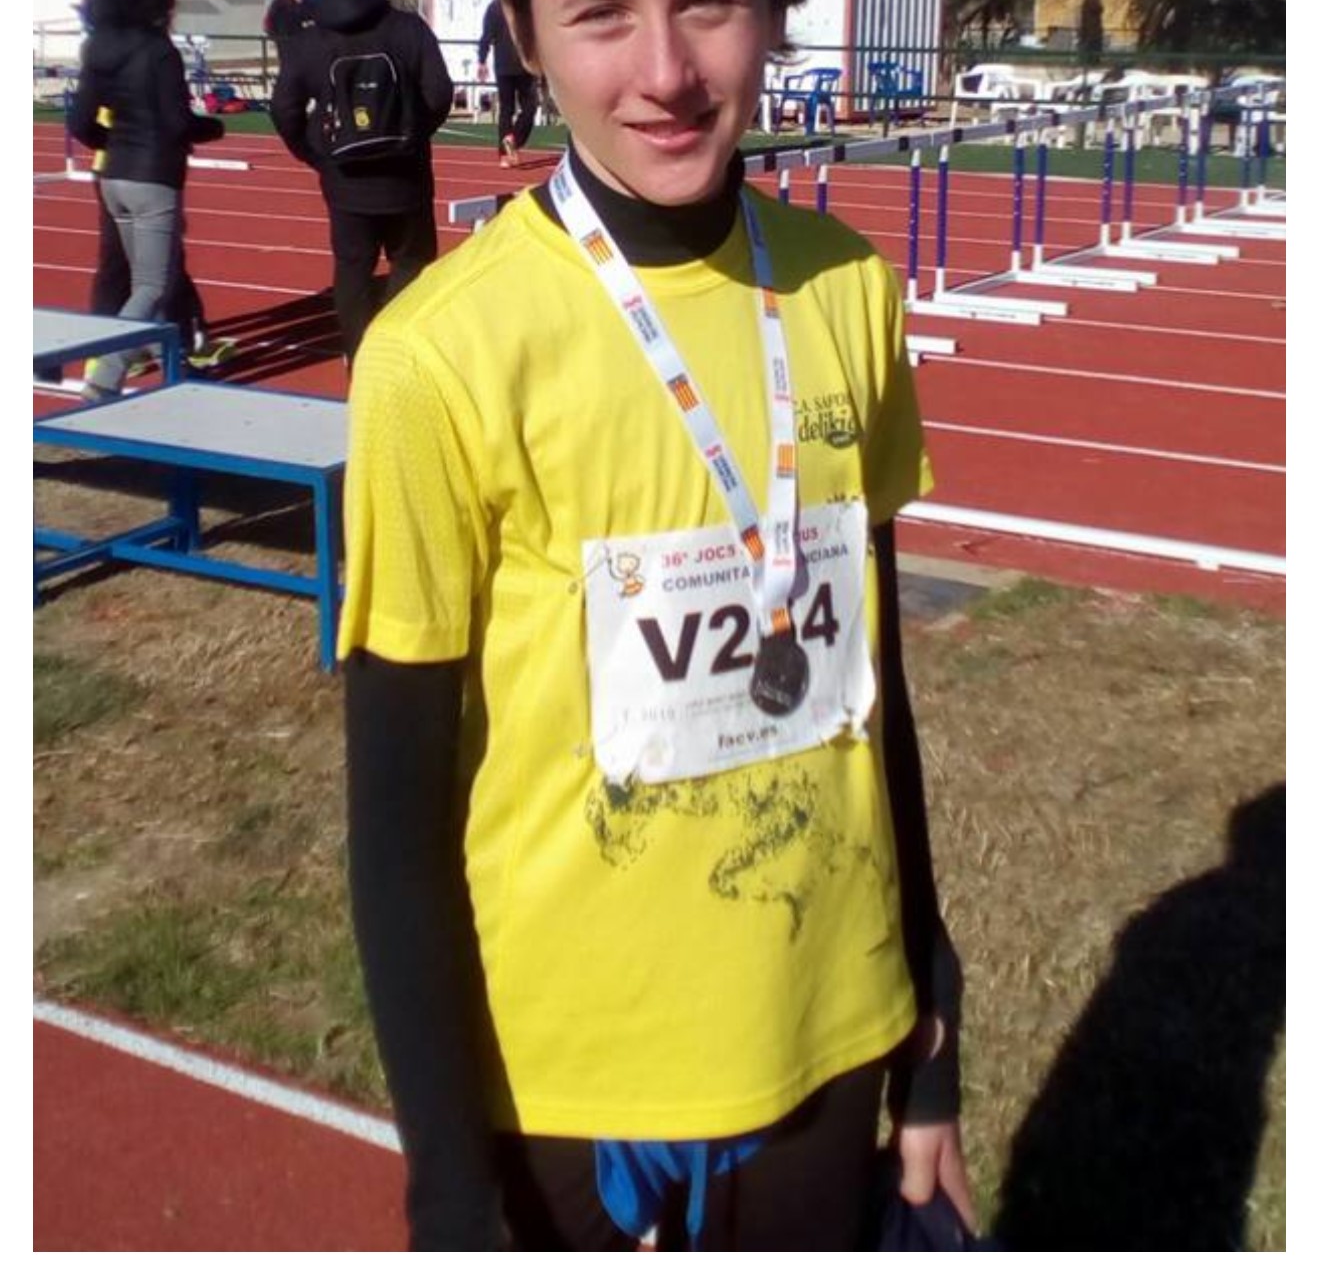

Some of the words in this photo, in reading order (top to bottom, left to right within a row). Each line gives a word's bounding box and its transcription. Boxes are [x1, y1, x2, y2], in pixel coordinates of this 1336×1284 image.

[694, 543, 736, 564] JOCS
[662, 565, 750, 593] COMUNITA
[637, 582, 840, 683] V24
